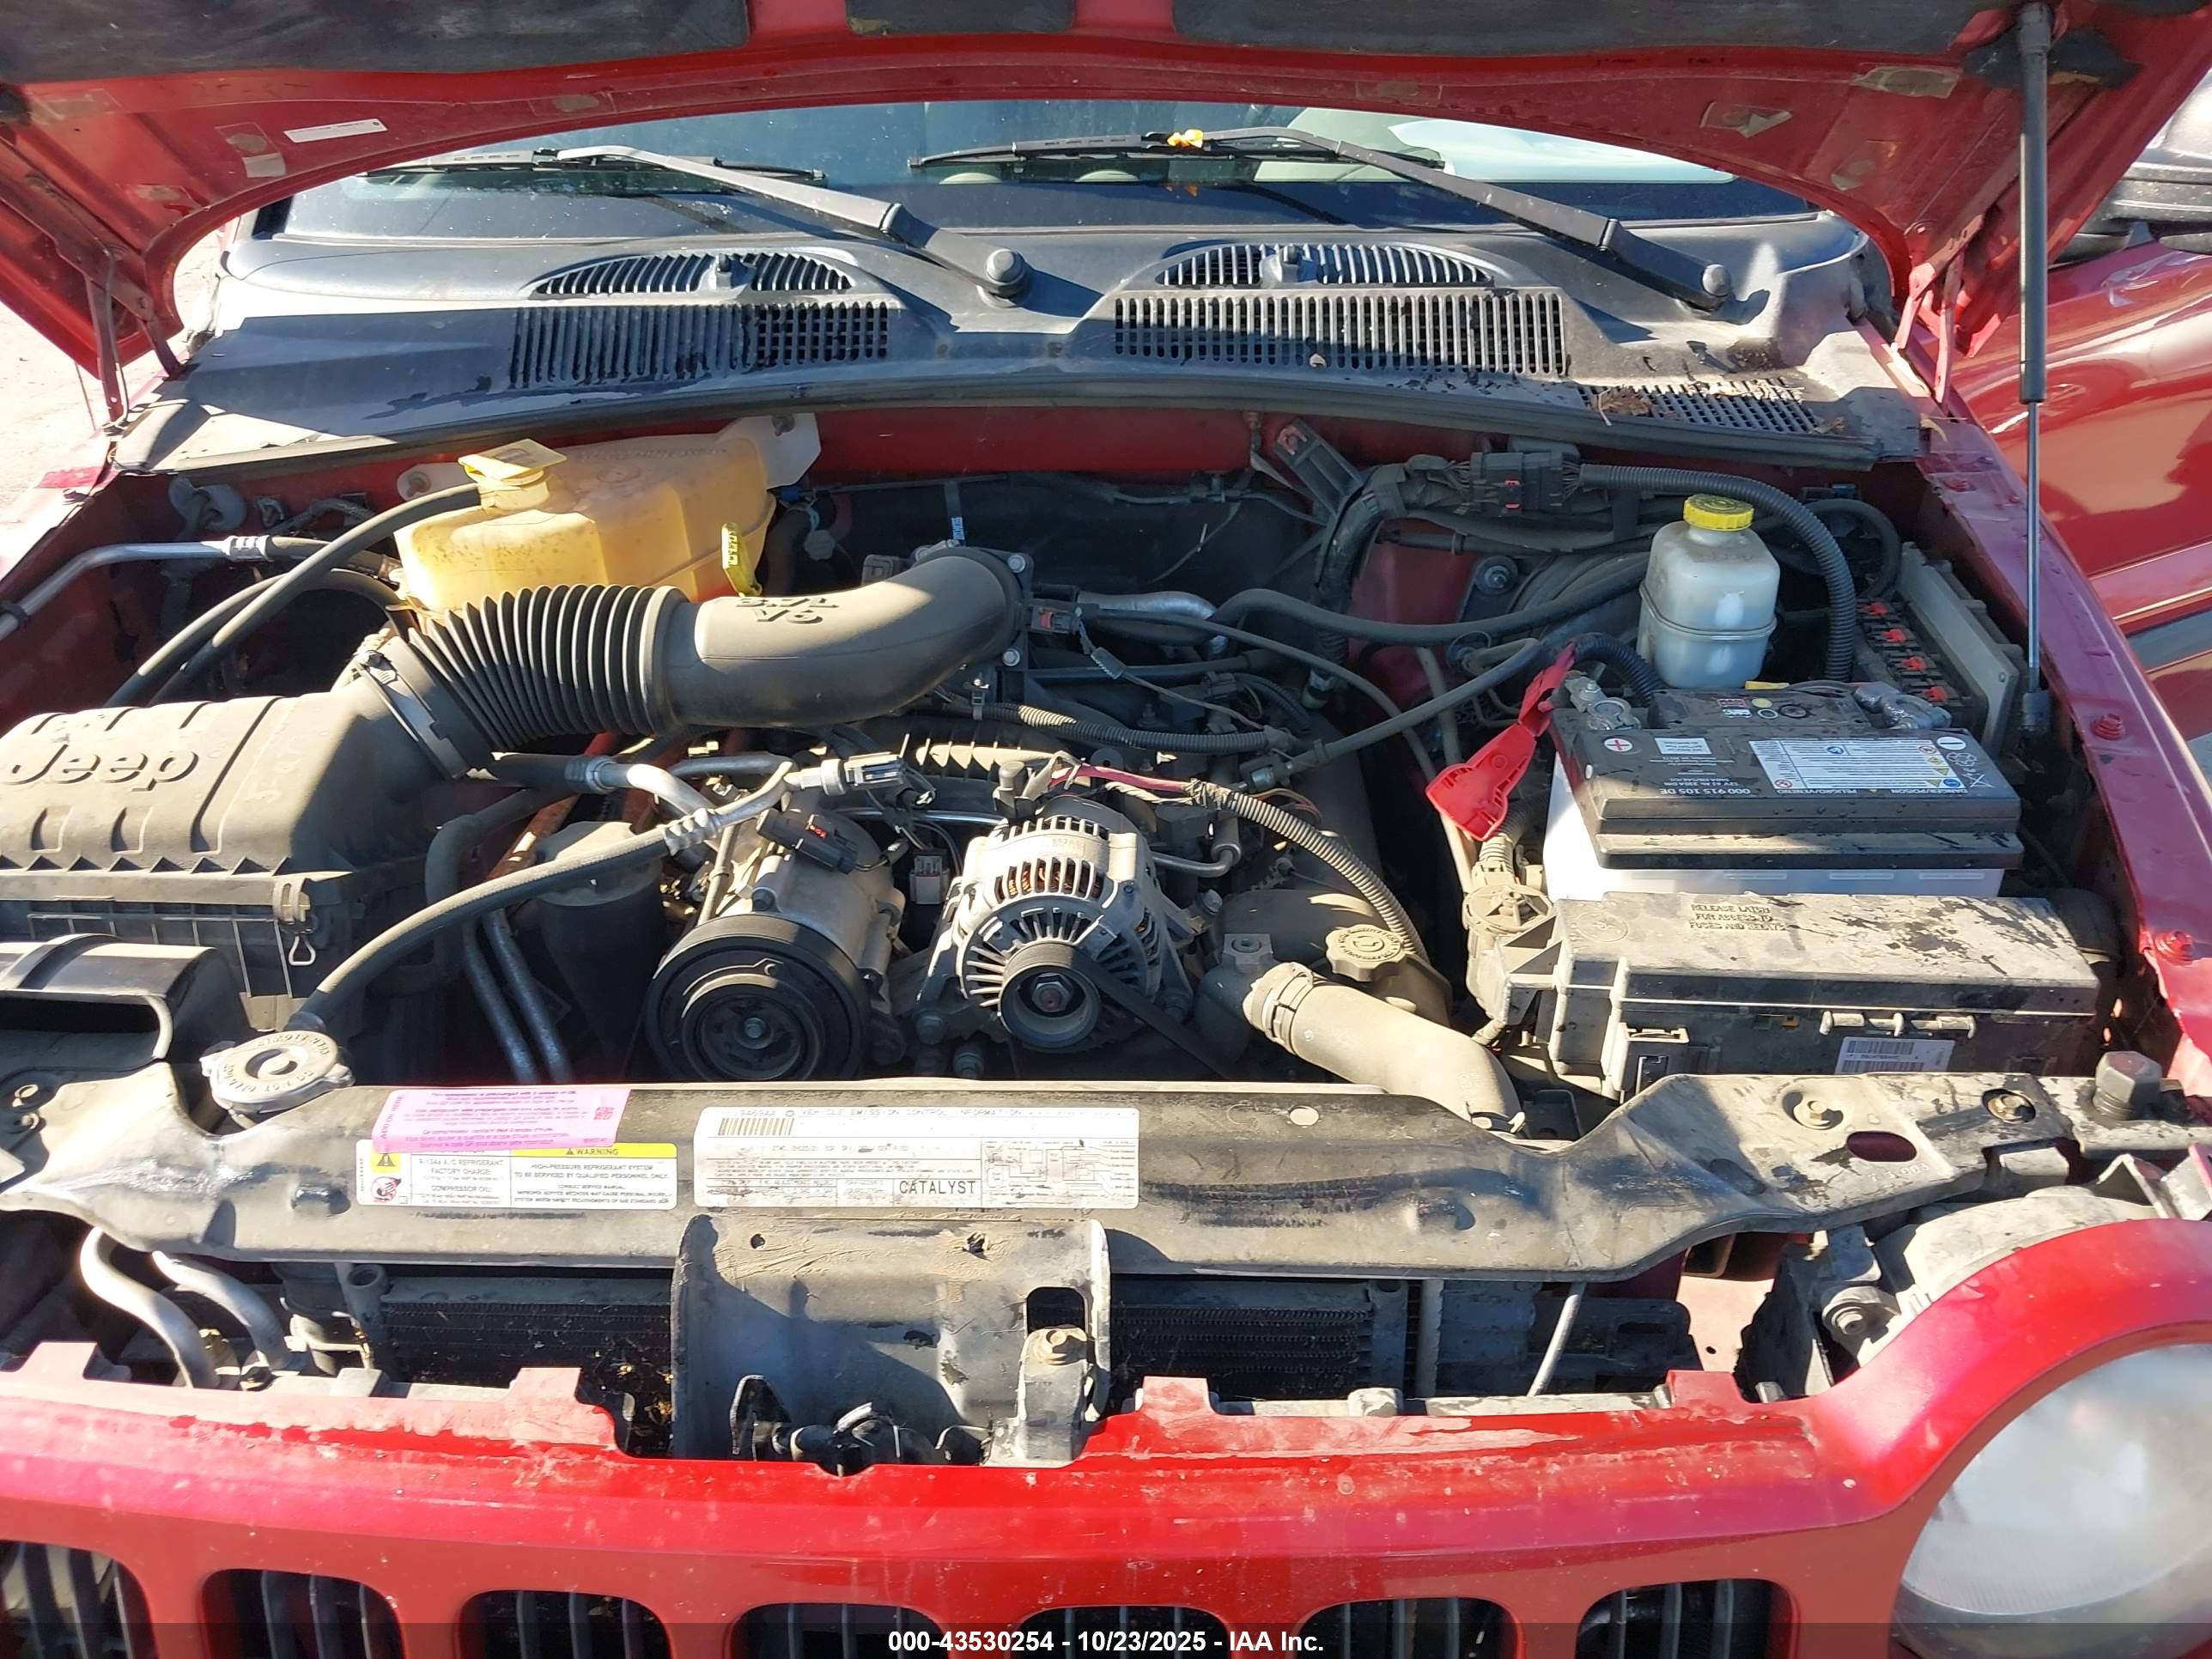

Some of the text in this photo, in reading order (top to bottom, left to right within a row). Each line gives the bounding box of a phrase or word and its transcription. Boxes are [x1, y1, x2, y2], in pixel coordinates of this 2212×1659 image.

[749, 608, 824, 625] V6
[2, 744, 199, 792] Jeep
[1690, 903, 1771, 914] RELEASE LATCH
[898, 1180, 976, 1195] CATALYST
